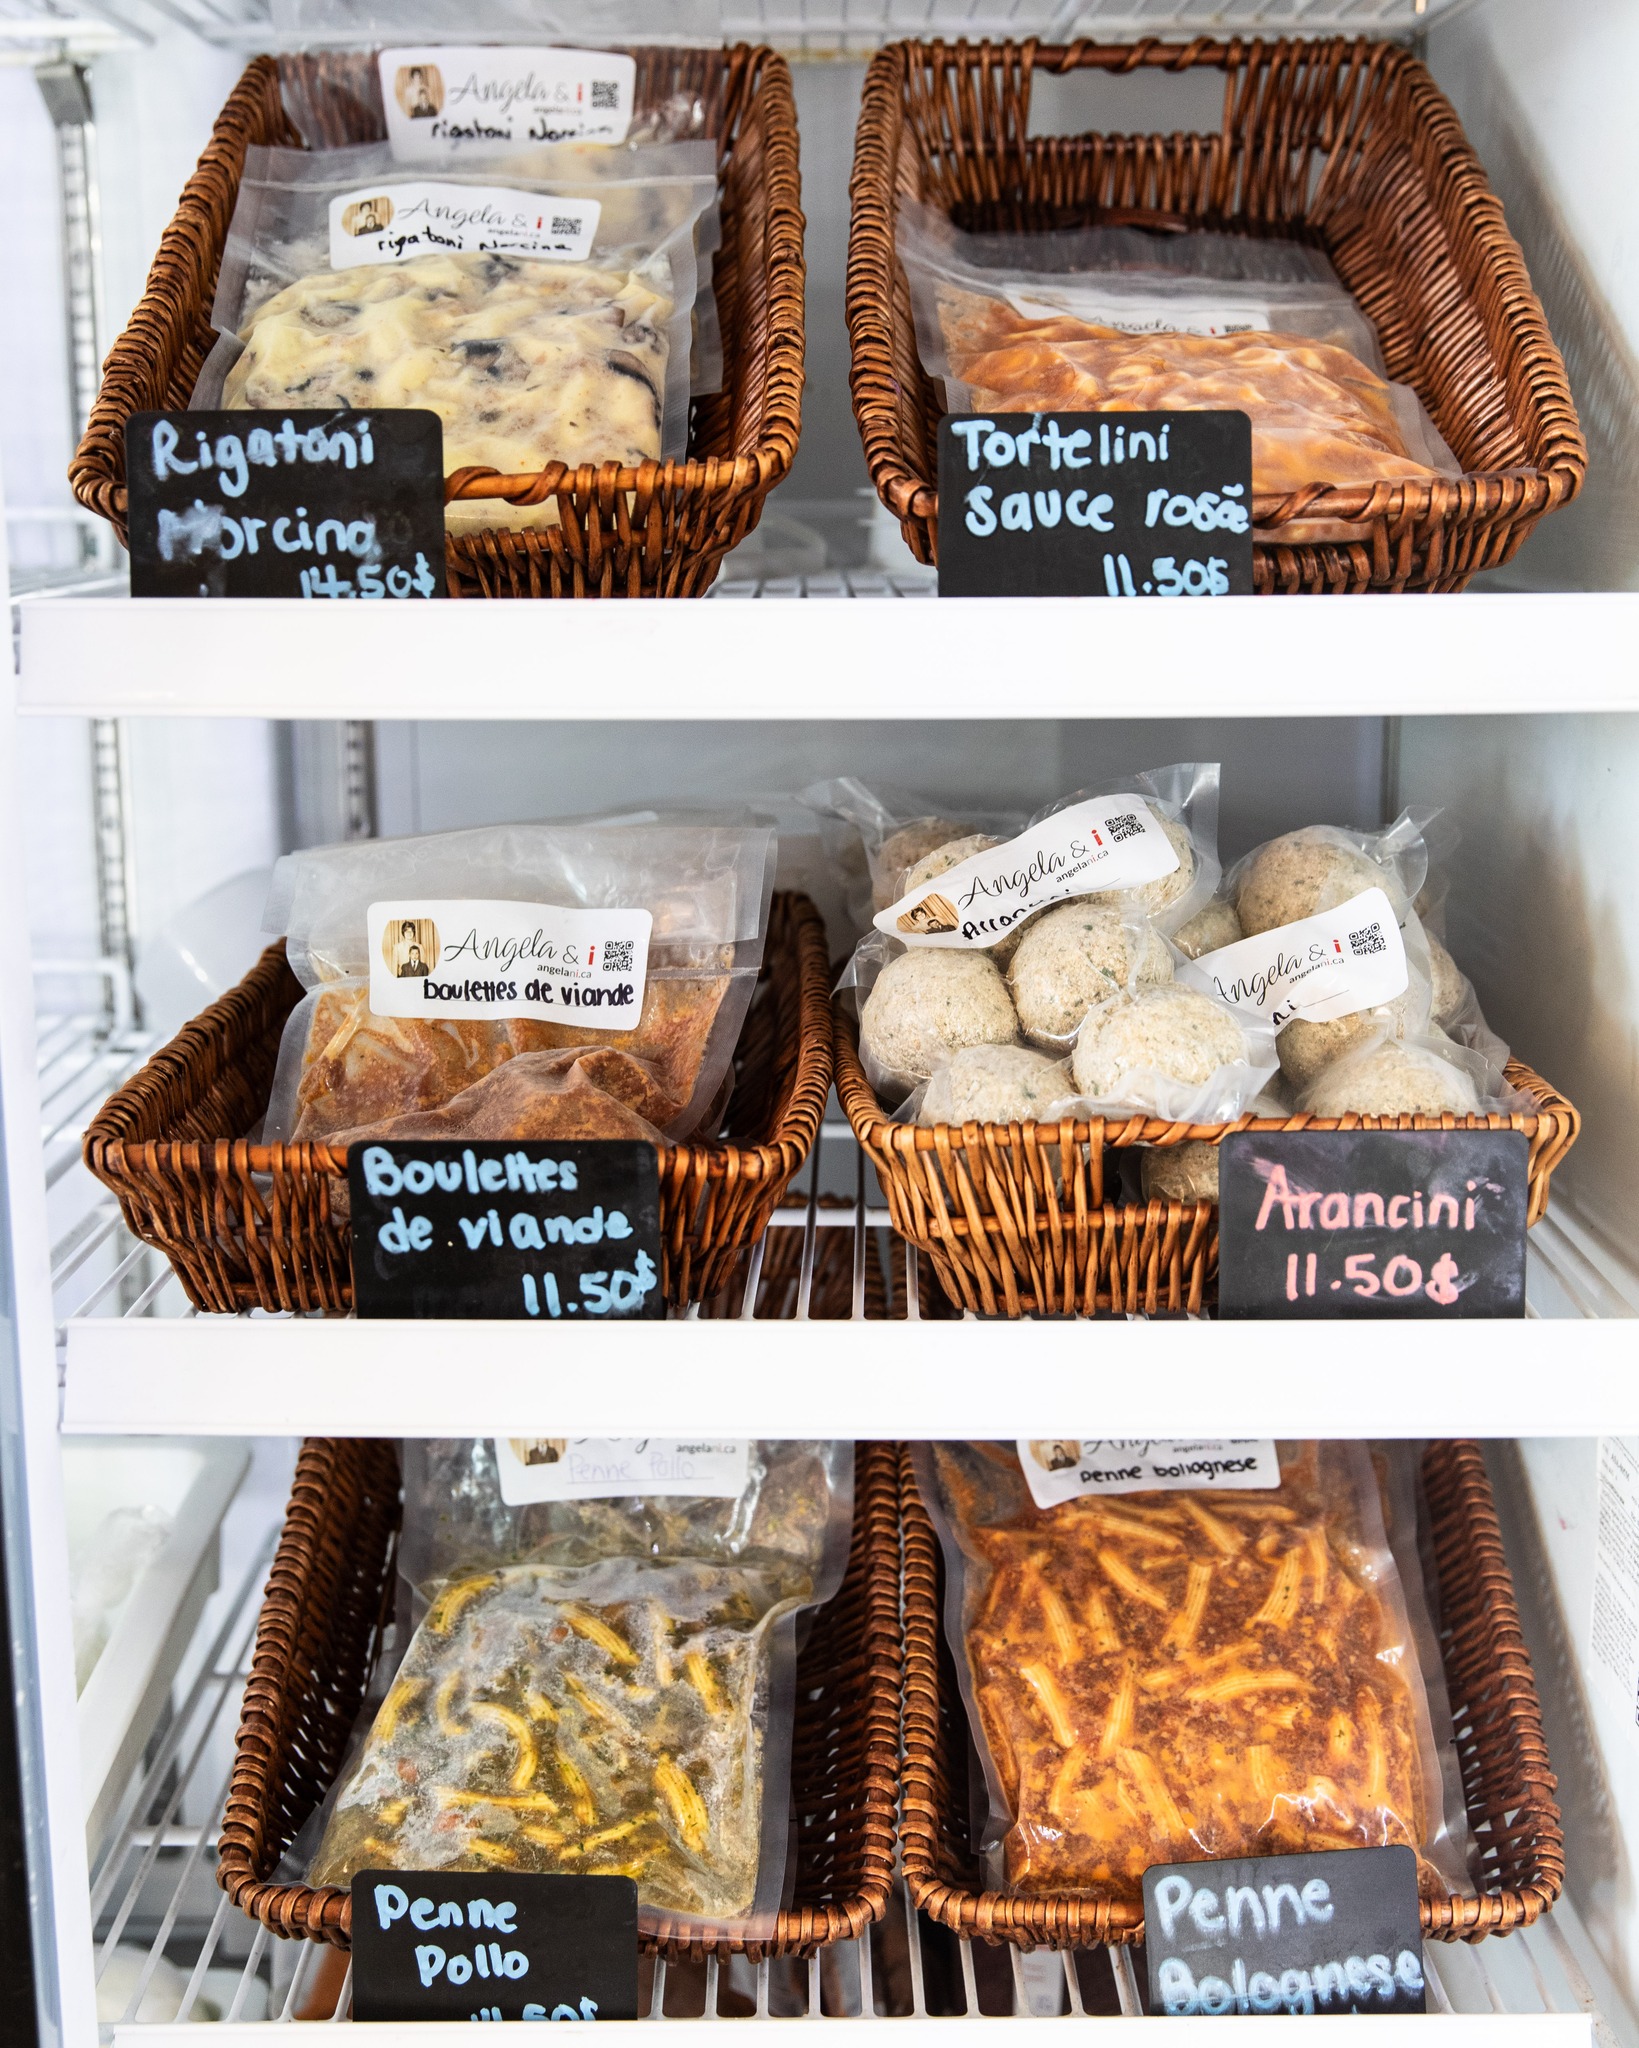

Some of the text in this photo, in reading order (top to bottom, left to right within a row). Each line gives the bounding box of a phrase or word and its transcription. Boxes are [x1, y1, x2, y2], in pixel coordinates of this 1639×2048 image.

[448, 71, 548, 114] Angela
[398, 198, 508, 229] Angela
[152, 418, 374, 498] Rigatoni
[950, 418, 1170, 471] Tortelini
[958, 829, 1103, 911] Angela & i
[1055, 849, 1109, 883] angelani.ca
[444, 928, 596, 973] Angela & i
[536, 963, 592, 979] angelani.ca
[1289, 956, 1345, 984] angelani.ca
[1308, 943, 1327, 962] &
[1332, 939, 1342, 953] i
[423, 978, 635, 1006] boulettes de viande
[362, 1146, 579, 1197] Boulettes
[1254, 1163, 1475, 1232] Arancini
[377, 1205, 634, 1254] de viande
[522, 1248, 658, 1318] 11.50$
[1285, 1252, 1460, 1305] 11.50$
[567, 1451, 697, 1482] Penne Pollo
[373, 1883, 518, 1933] Penne
[1154, 1874, 1335, 1941] Penne
[414, 1942, 530, 1987] Pollo
[1158, 1949, 1426, 2015] Bolognese
